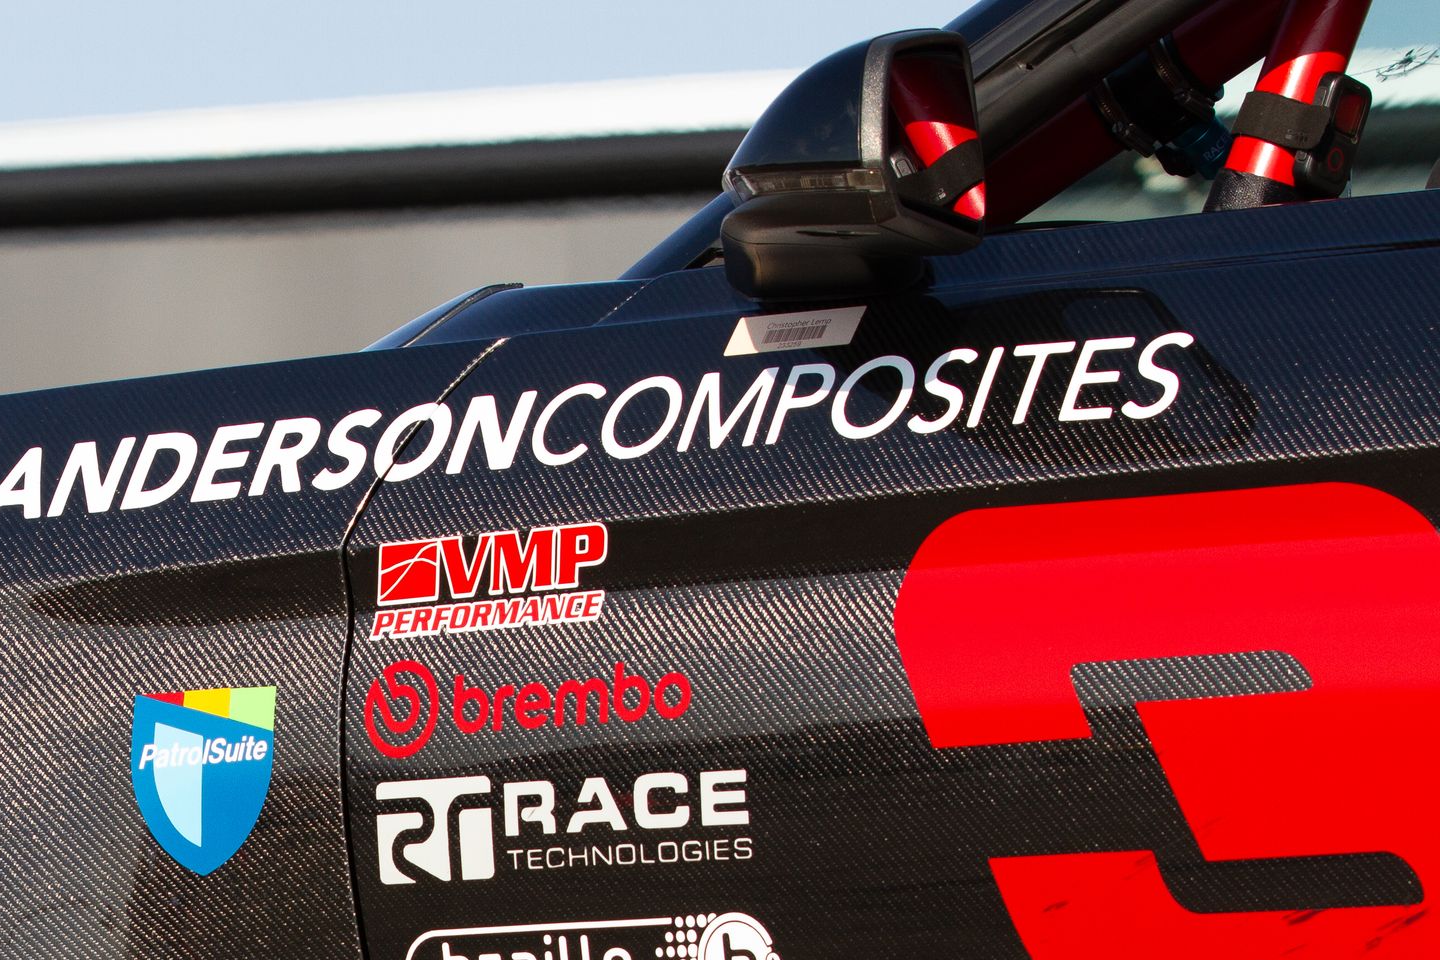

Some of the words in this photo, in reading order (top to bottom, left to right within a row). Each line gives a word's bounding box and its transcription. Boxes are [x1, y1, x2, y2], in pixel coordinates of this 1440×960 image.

[436, 522, 608, 599] VMP
[369, 589, 605, 641] PERFORMANCE
[453, 661, 692, 734] brembo
[138, 735, 268, 770] PatrolSuite
[502, 768, 750, 837] RACE
[506, 837, 754, 870] TECHNOLOGIES
